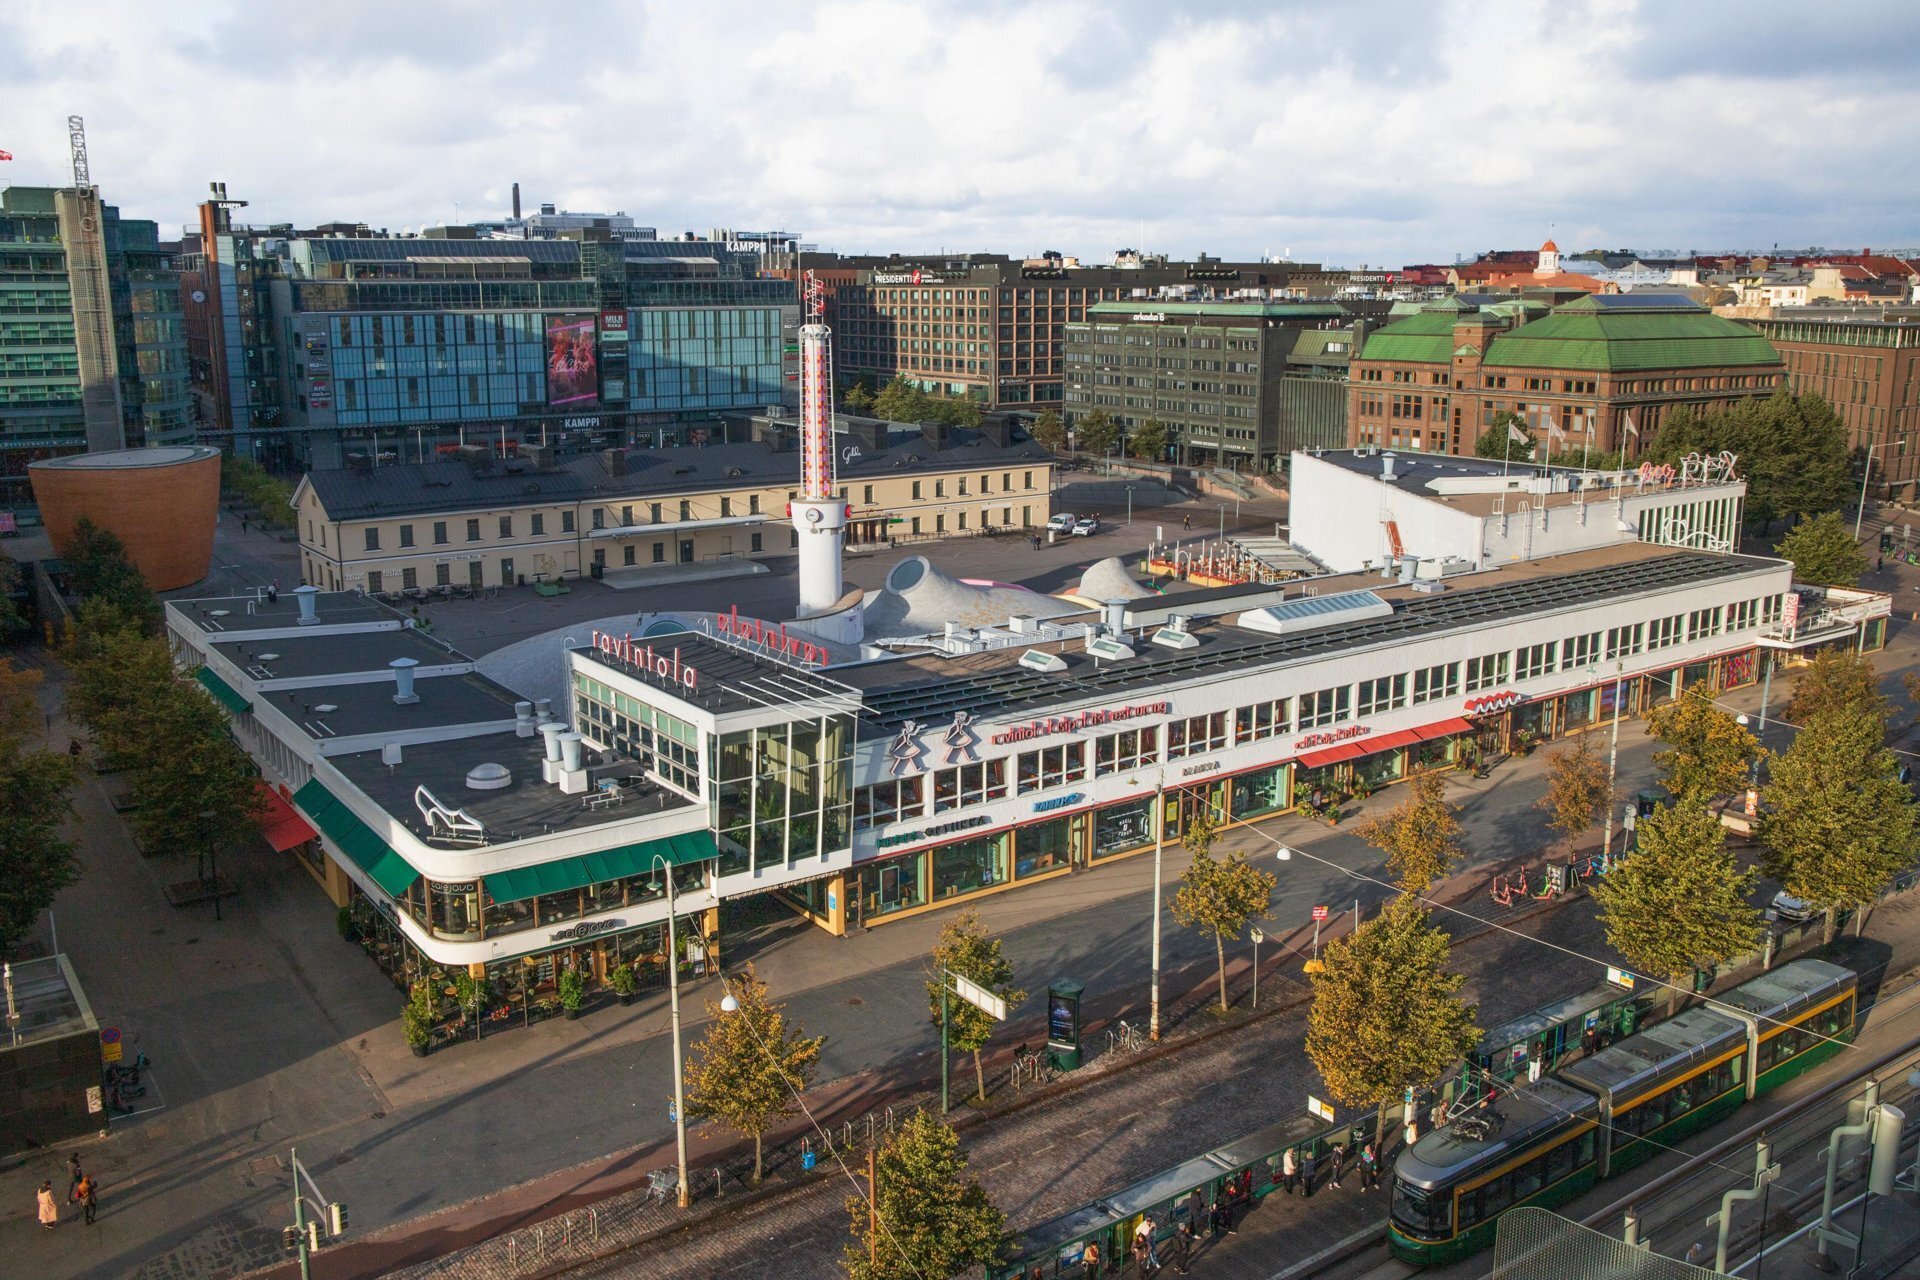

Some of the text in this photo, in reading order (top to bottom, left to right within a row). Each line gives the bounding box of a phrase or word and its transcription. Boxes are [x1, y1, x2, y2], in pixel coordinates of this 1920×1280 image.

[726, 241, 766, 253] KAMPPI
[875, 274, 912, 284] PRESIDENTTI
[243, 289, 249, 297] 5
[605, 315, 623, 324] MUJI
[1132, 311, 1158, 321] arkadia
[564, 416, 600, 428] KAMPPI
[1680, 450, 1738, 487] REX
[1784, 593, 1798, 628] REX
[593, 629, 697, 689] ravintola
[991, 720, 1043, 745] ravintola
[1109, 701, 1170, 721] restaurang
